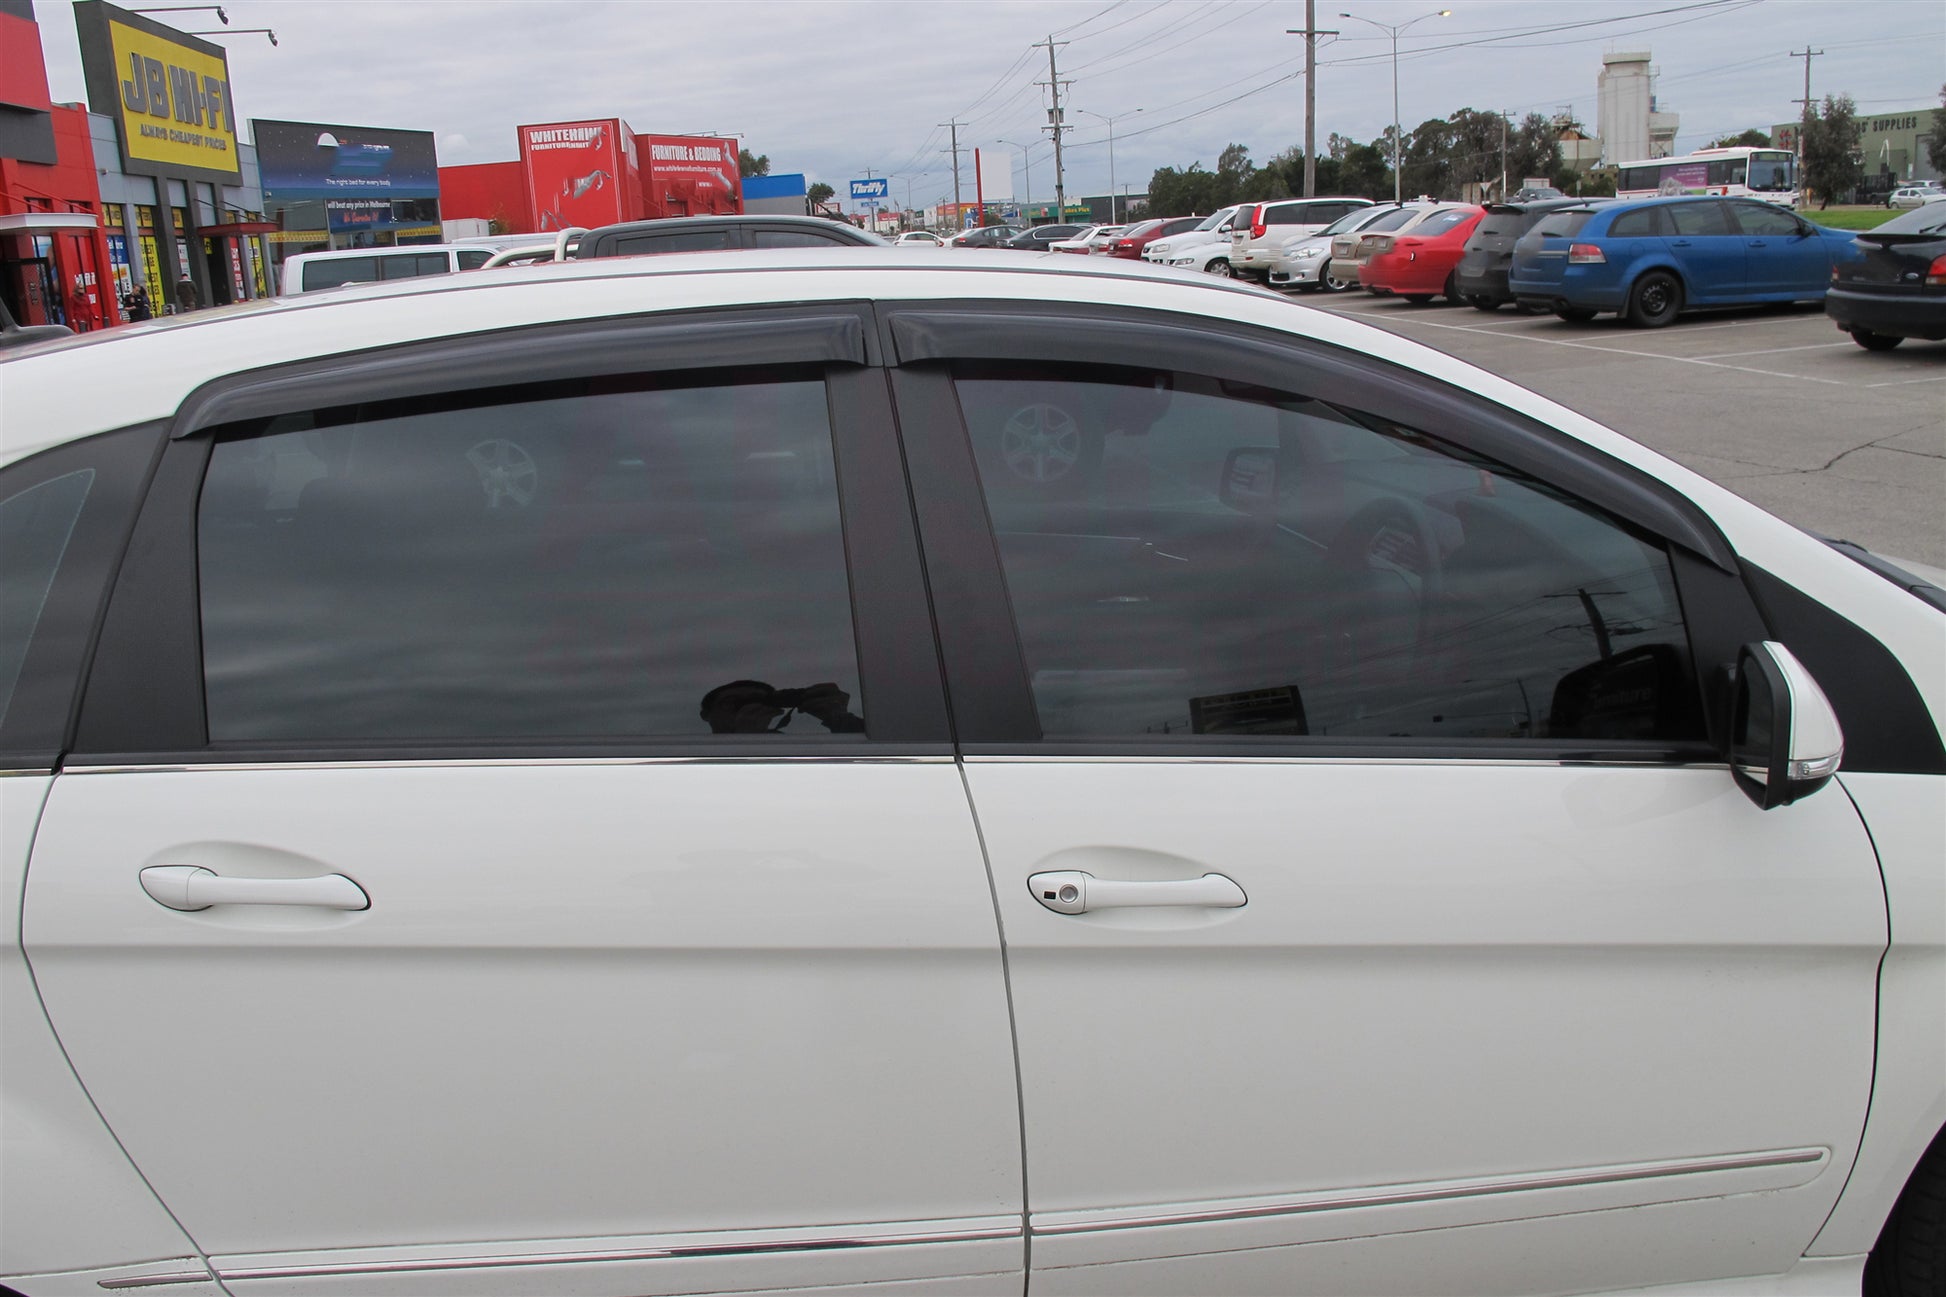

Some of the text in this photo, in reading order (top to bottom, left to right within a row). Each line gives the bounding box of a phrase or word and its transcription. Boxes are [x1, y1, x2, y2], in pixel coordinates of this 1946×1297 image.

[122, 52, 233, 133] JB HI-FI
[1873, 116, 1917, 132] SUPPLIES
[140, 123, 227, 151] ALWAYS CHEAPEST PRICES
[651, 144, 722, 162] FURNITURE & BEDDING
[852, 182, 885, 196] Thrifty
[355, 201, 364, 209] price
